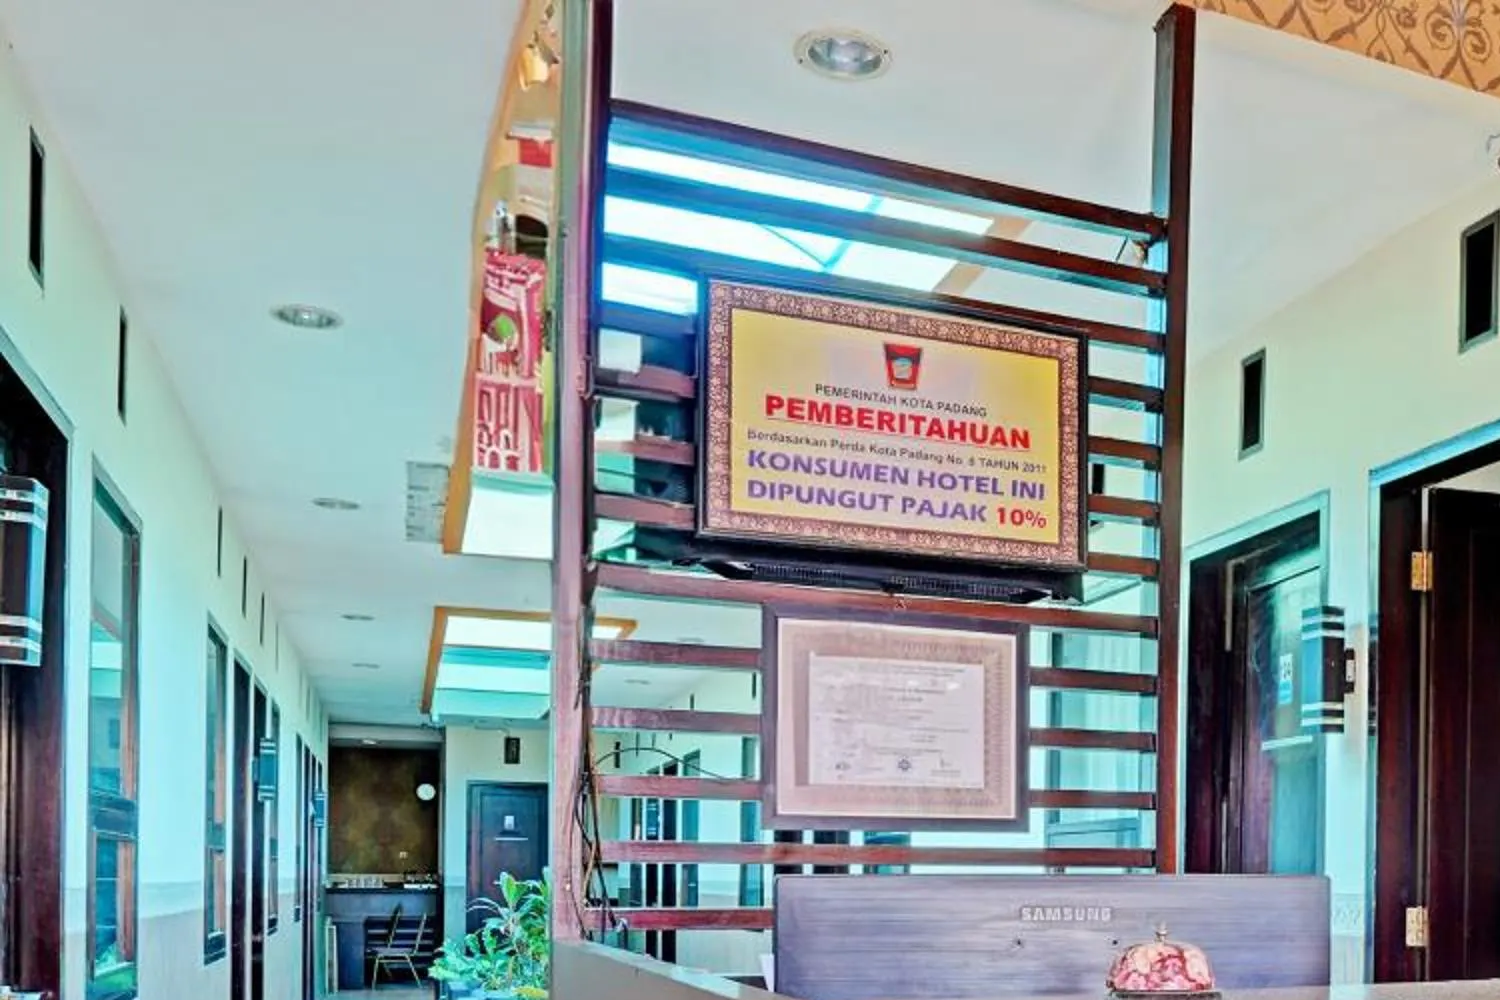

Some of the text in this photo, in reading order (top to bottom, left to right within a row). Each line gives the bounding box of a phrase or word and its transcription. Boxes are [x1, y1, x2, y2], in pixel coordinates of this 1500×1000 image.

[765, 394, 1031, 449] PEMBERITAHUAN
[815, 383, 987, 417] PEMERINTAH KOTA PADANG
[747, 428, 827, 448] Berdasarkan
[830, 438, 865, 453] Perda
[869, 444, 897, 457] Kota
[900, 448, 943, 465] Padang
[980, 457, 1019, 473] TAHUN
[747, 449, 1046, 501] KONSUMEN HOTEL INI
[747, 479, 1047, 529] DIPUNGUT PAJAK 10%
[1020, 906, 1112, 922] SAMSUNG
